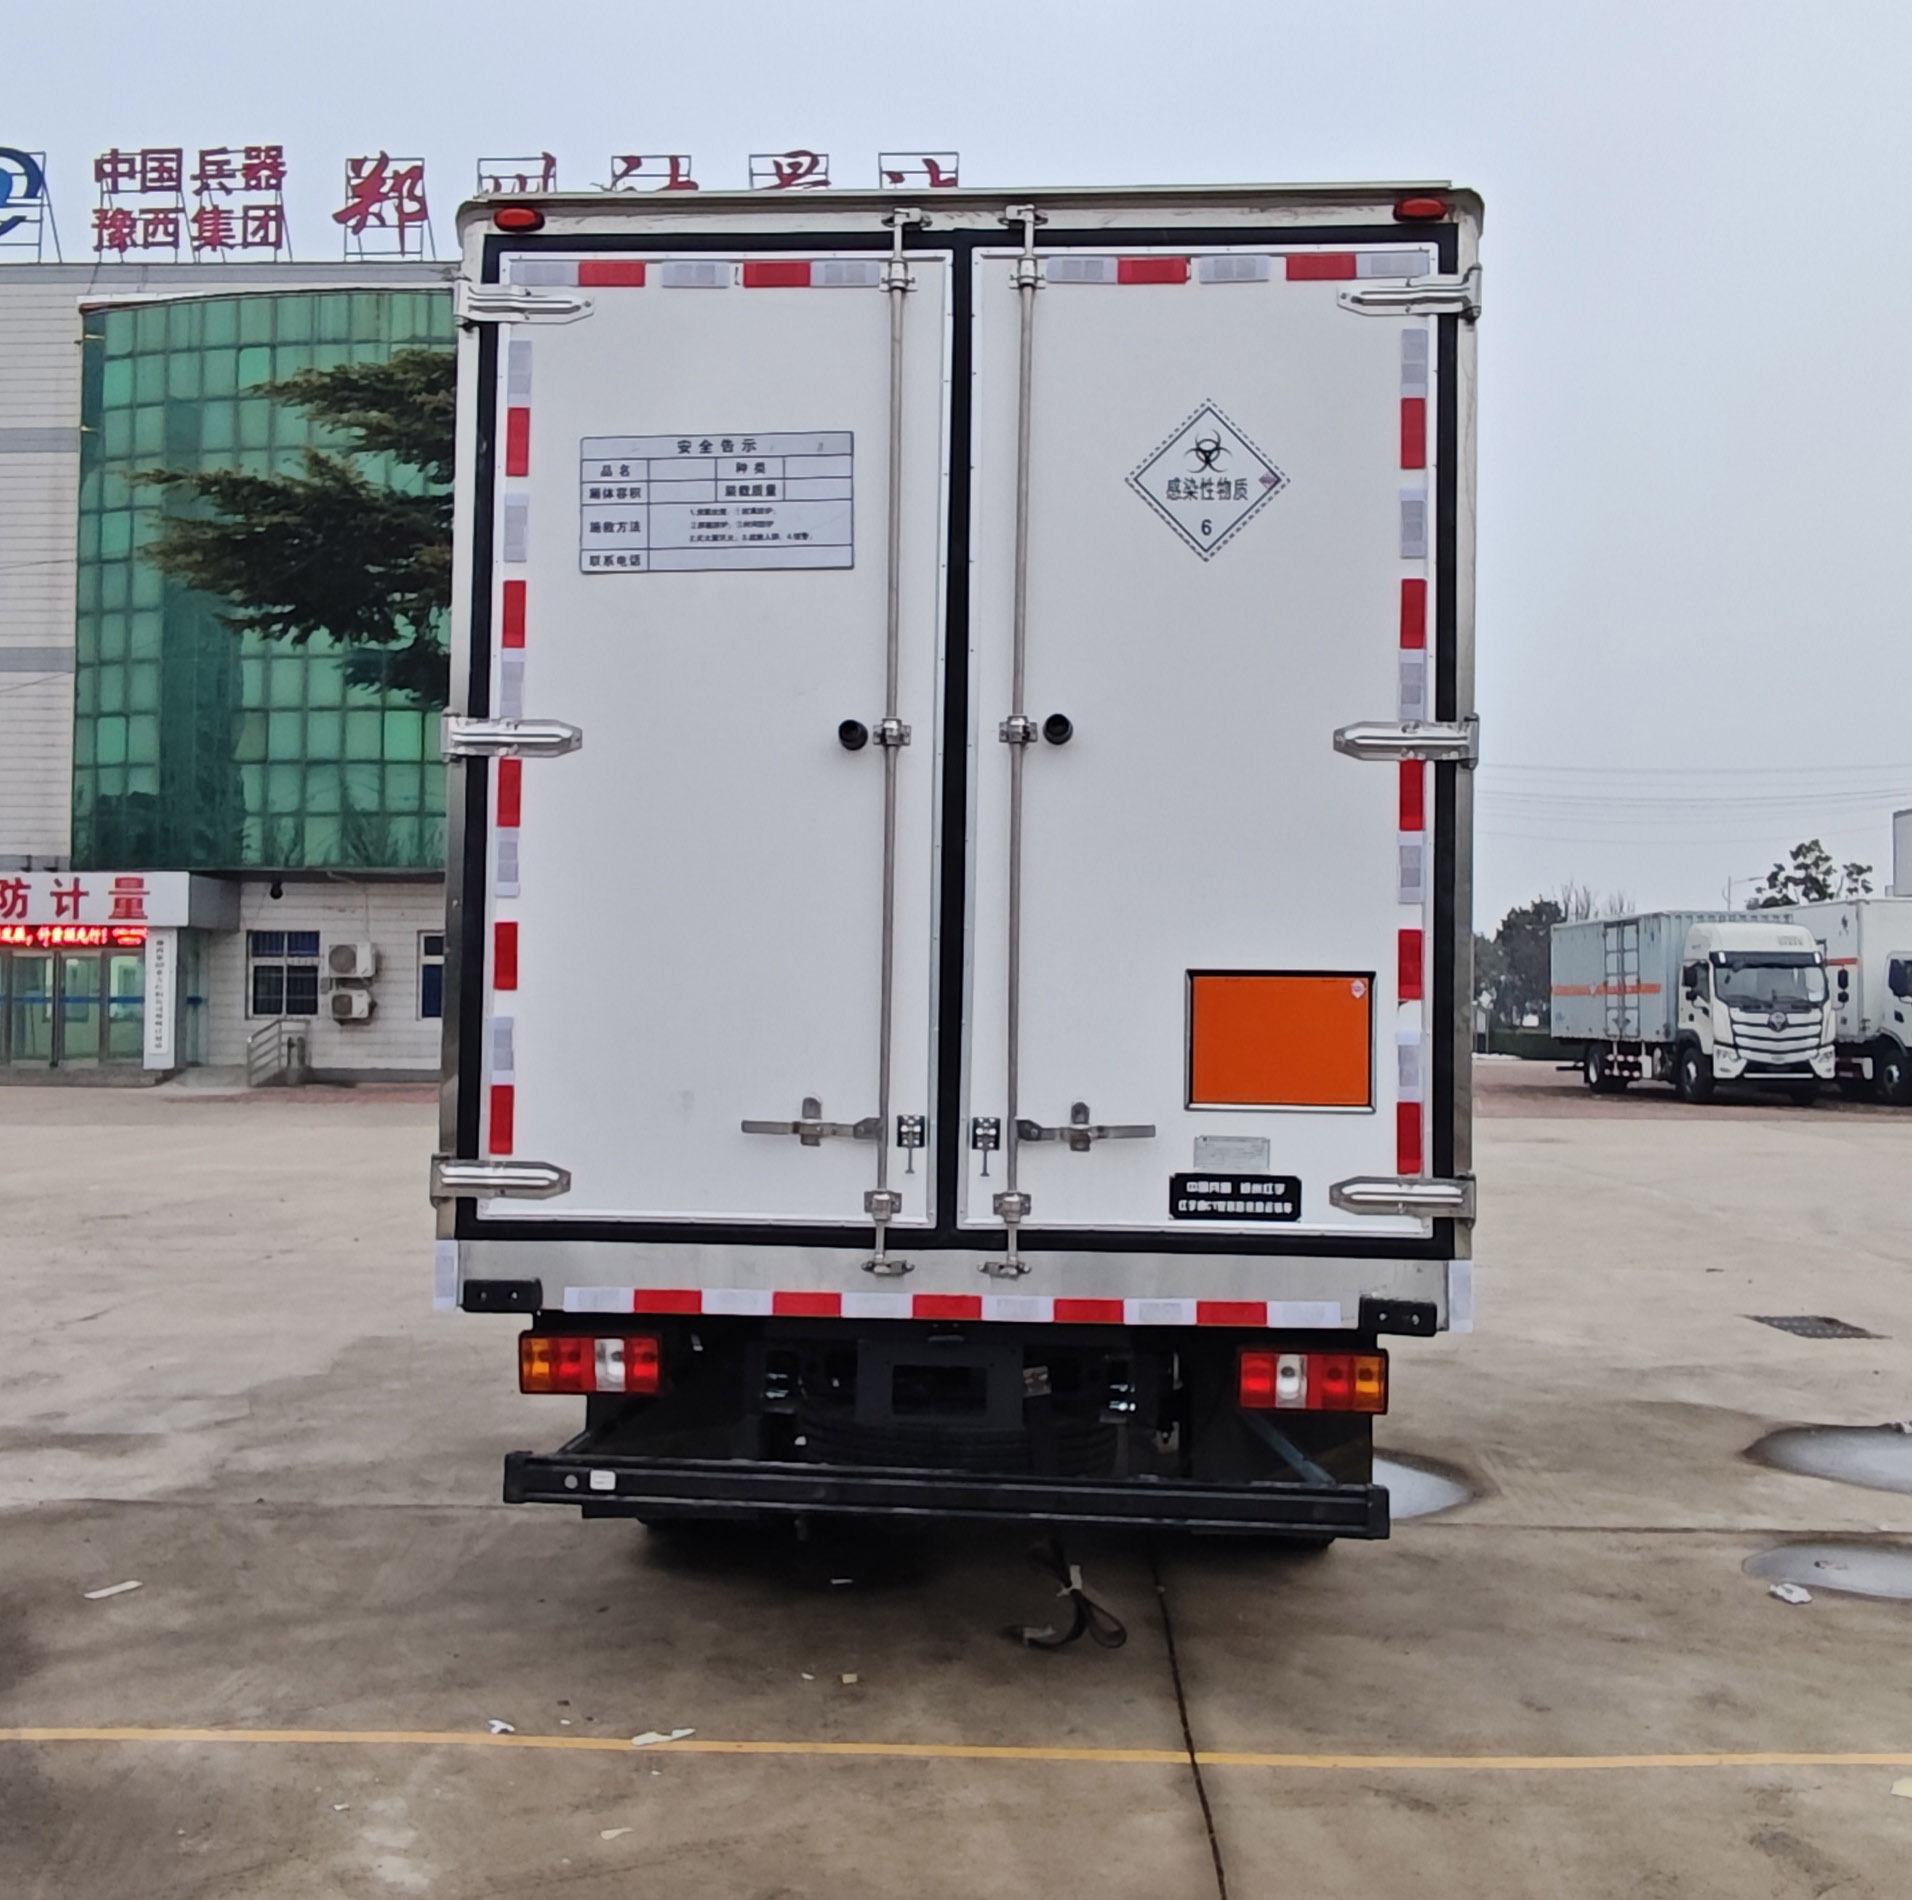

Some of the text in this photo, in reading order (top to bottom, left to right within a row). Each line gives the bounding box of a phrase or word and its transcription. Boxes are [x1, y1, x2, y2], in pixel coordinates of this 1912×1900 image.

[94, 145, 287, 196] 中国兵器
[91, 204, 284, 252] 豫西集团
[677, 438, 757, 454] 安全告示
[1166, 477, 1249, 501] 感染性物质
[1201, 518, 1212, 536] 6
